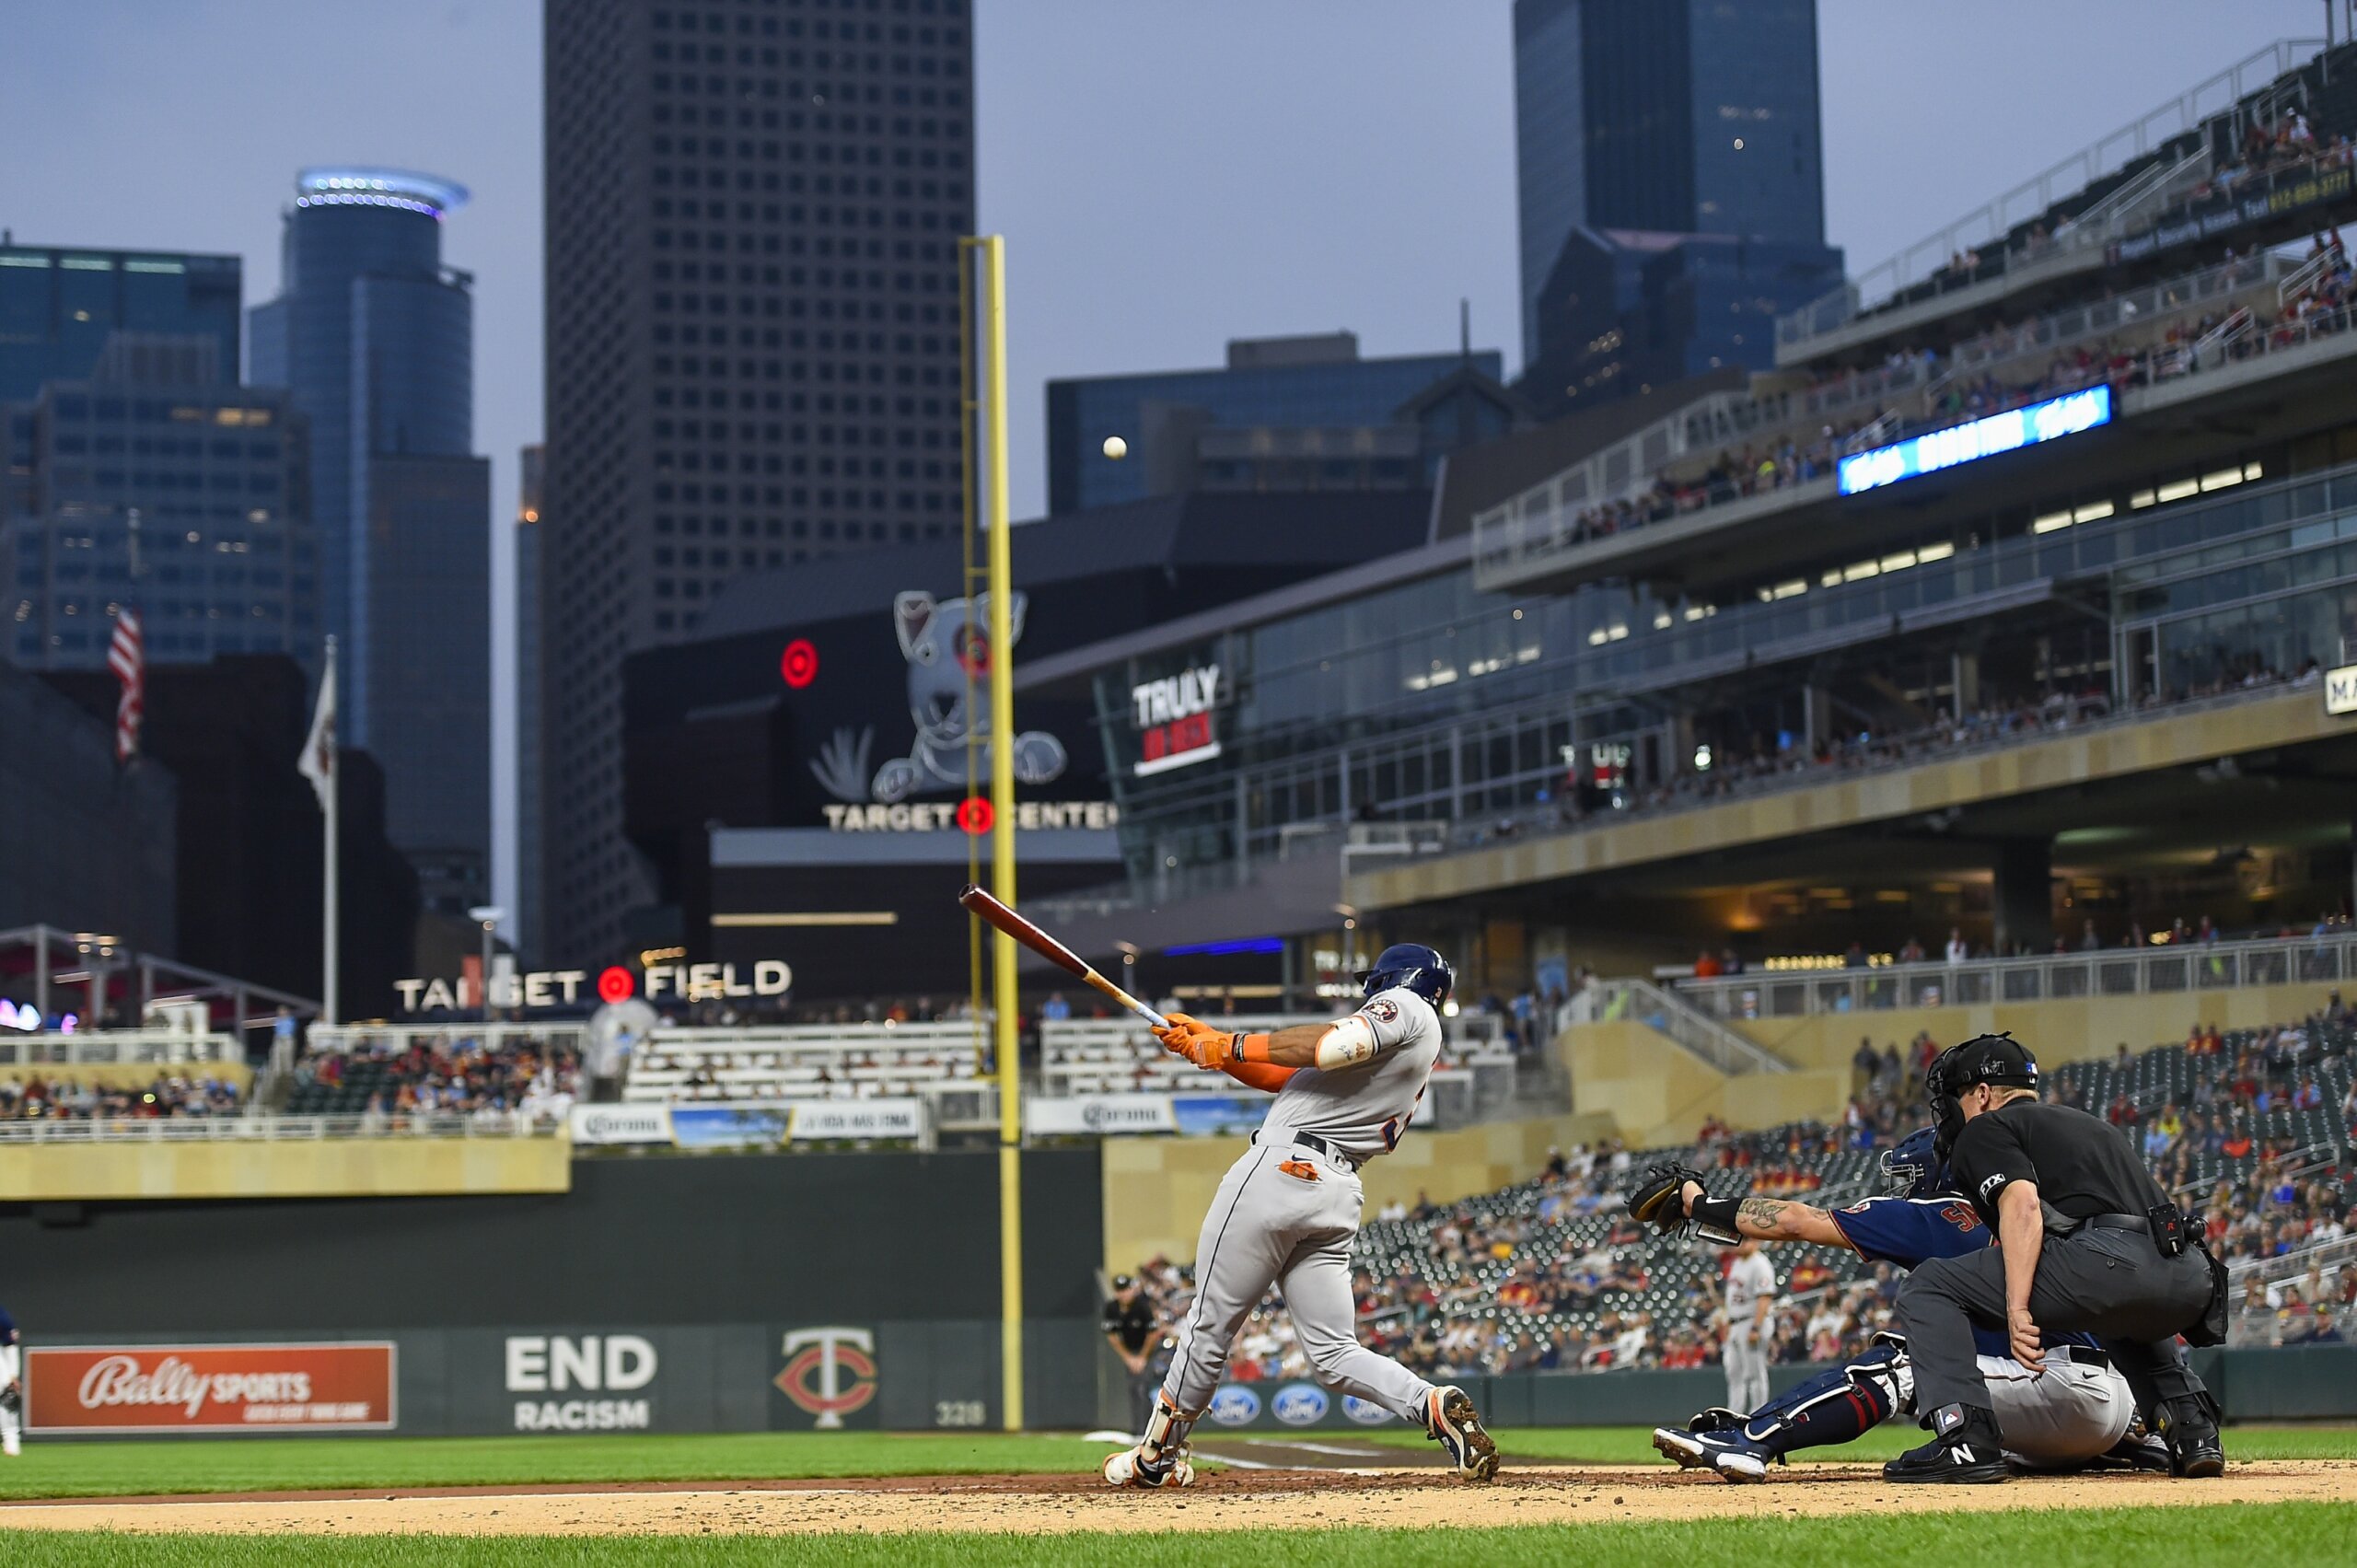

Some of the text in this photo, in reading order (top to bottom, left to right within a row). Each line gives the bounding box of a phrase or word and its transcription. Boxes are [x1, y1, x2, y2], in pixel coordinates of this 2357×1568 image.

[1132, 664, 1220, 726] TRULY
[823, 801, 1119, 830] TARGET ENTE
[644, 959, 792, 1000] FIELD
[505, 1336, 658, 1391] END
[78, 1354, 213, 1420] Bally
[211, 1372, 312, 1402] SPORTS
[515, 1400, 650, 1430] RACISM
[936, 1401, 987, 1426] 328
